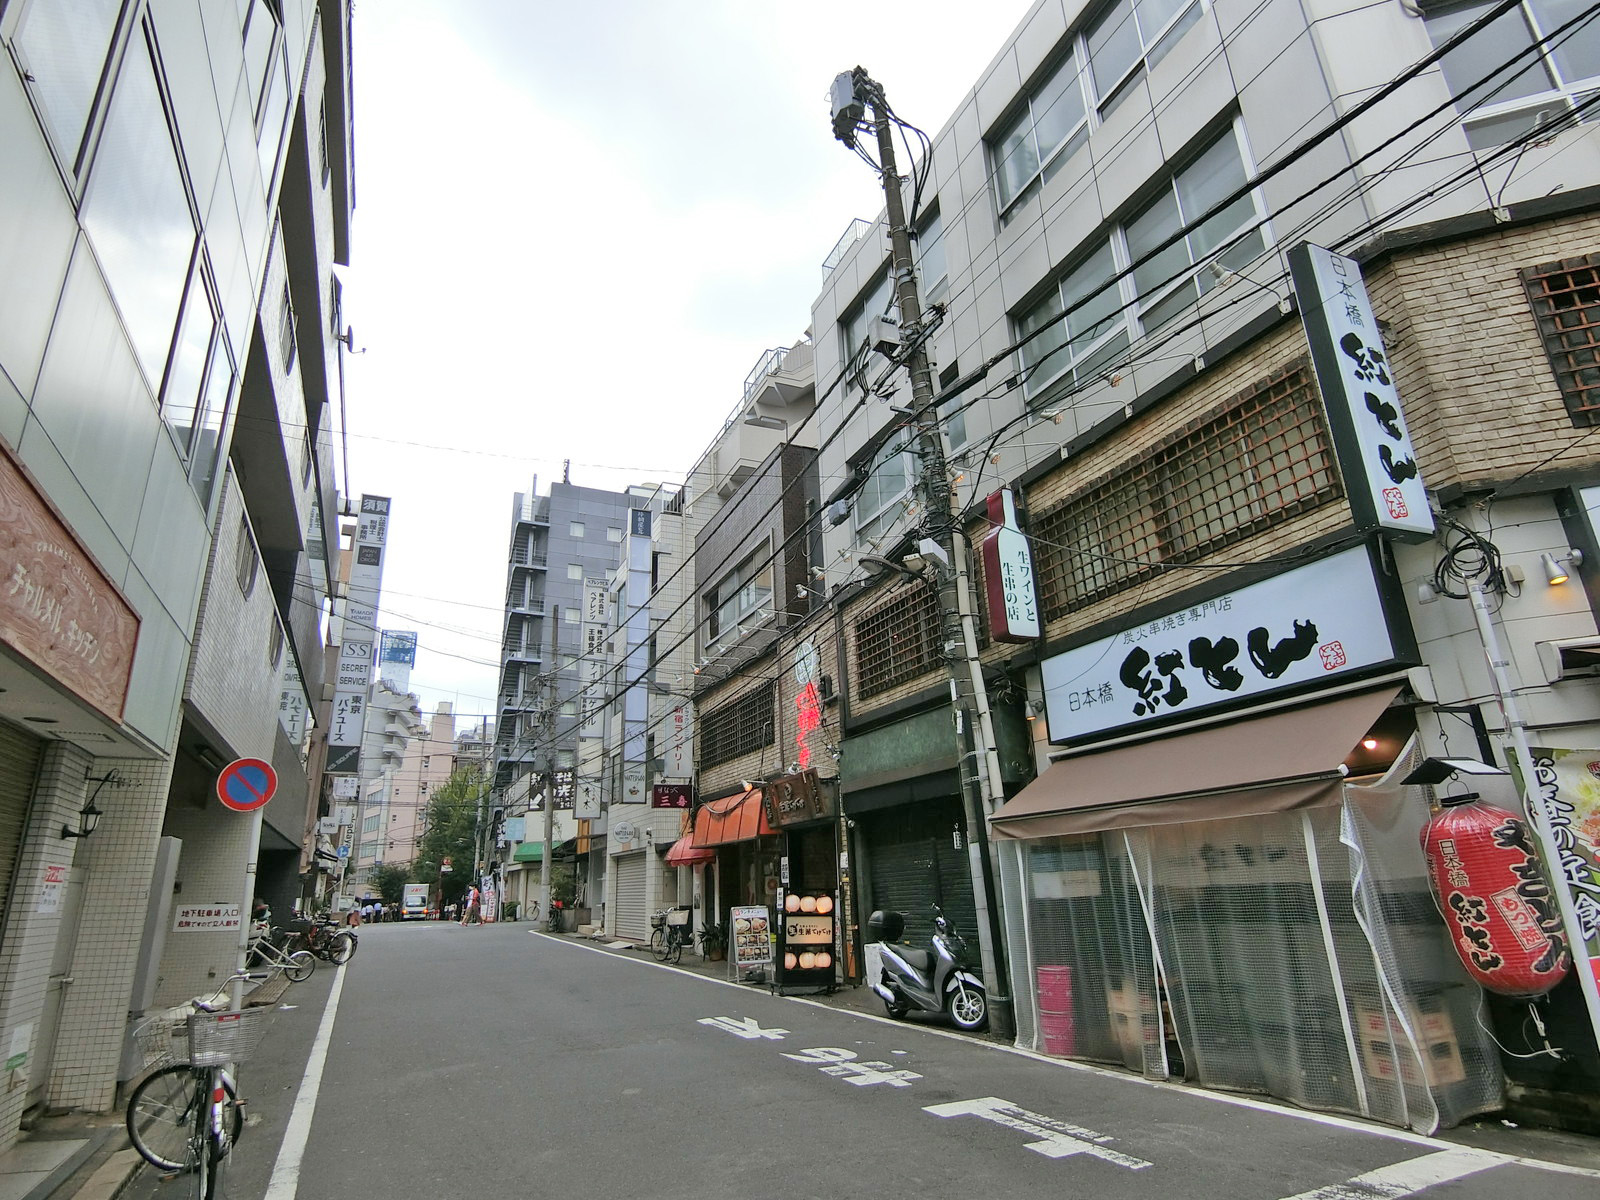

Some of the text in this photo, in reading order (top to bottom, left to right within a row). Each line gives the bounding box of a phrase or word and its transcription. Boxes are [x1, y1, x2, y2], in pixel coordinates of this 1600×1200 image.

[1329, 254, 1364, 329] 日本橋
[363, 500, 388, 512] 須賀
[1002, 562, 1020, 621] 生串の店
[1017, 551, 1036, 622] 生ワインと
[1122, 596, 1233, 645] 炭火串焼き専門店
[339, 676, 367, 686] SERVICE
[341, 663, 368, 672] SECRET
[350, 695, 362, 714] 東京
[1068, 682, 1114, 712] 日本橋
[1439, 840, 1469, 887] 日本橋
[181, 908, 239, 917] 地下駐車場 入口
